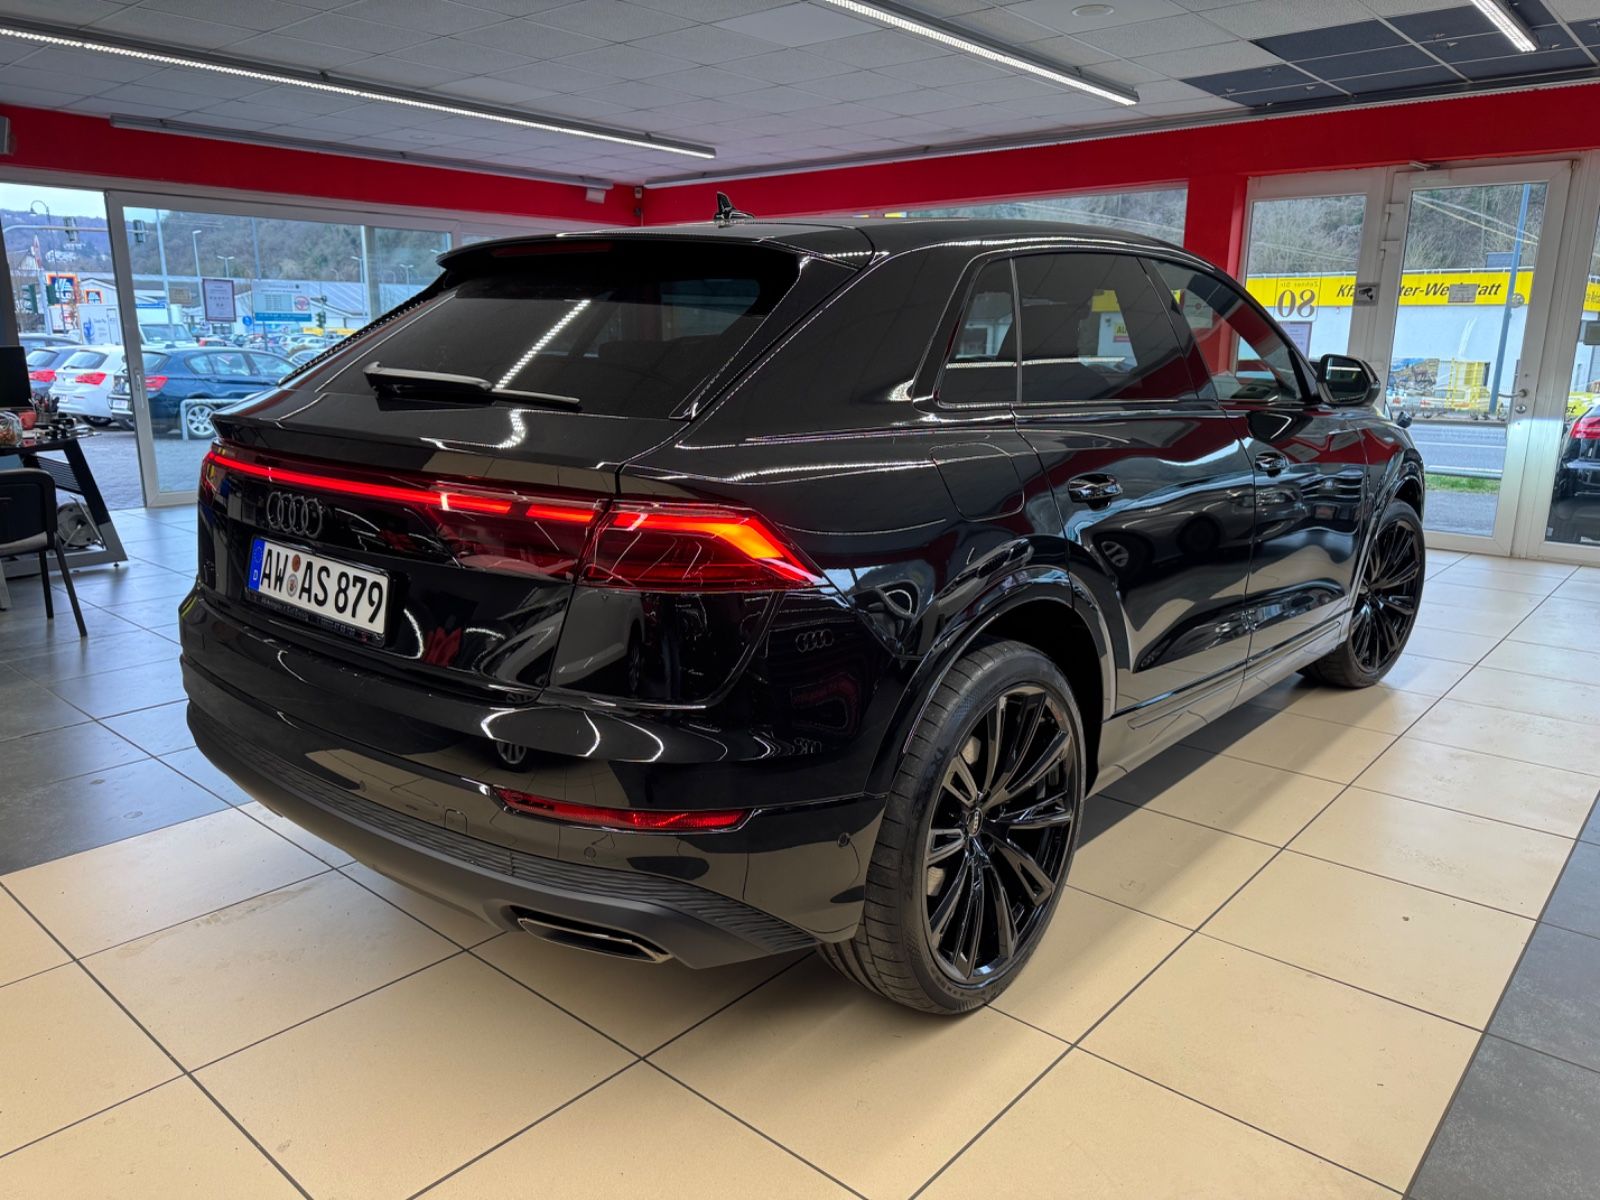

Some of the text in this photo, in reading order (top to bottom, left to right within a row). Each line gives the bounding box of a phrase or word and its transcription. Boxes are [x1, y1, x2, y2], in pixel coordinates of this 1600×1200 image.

[261, 549, 289, 593] AW
[298, 561, 331, 607] AS
[334, 571, 384, 624] 879
